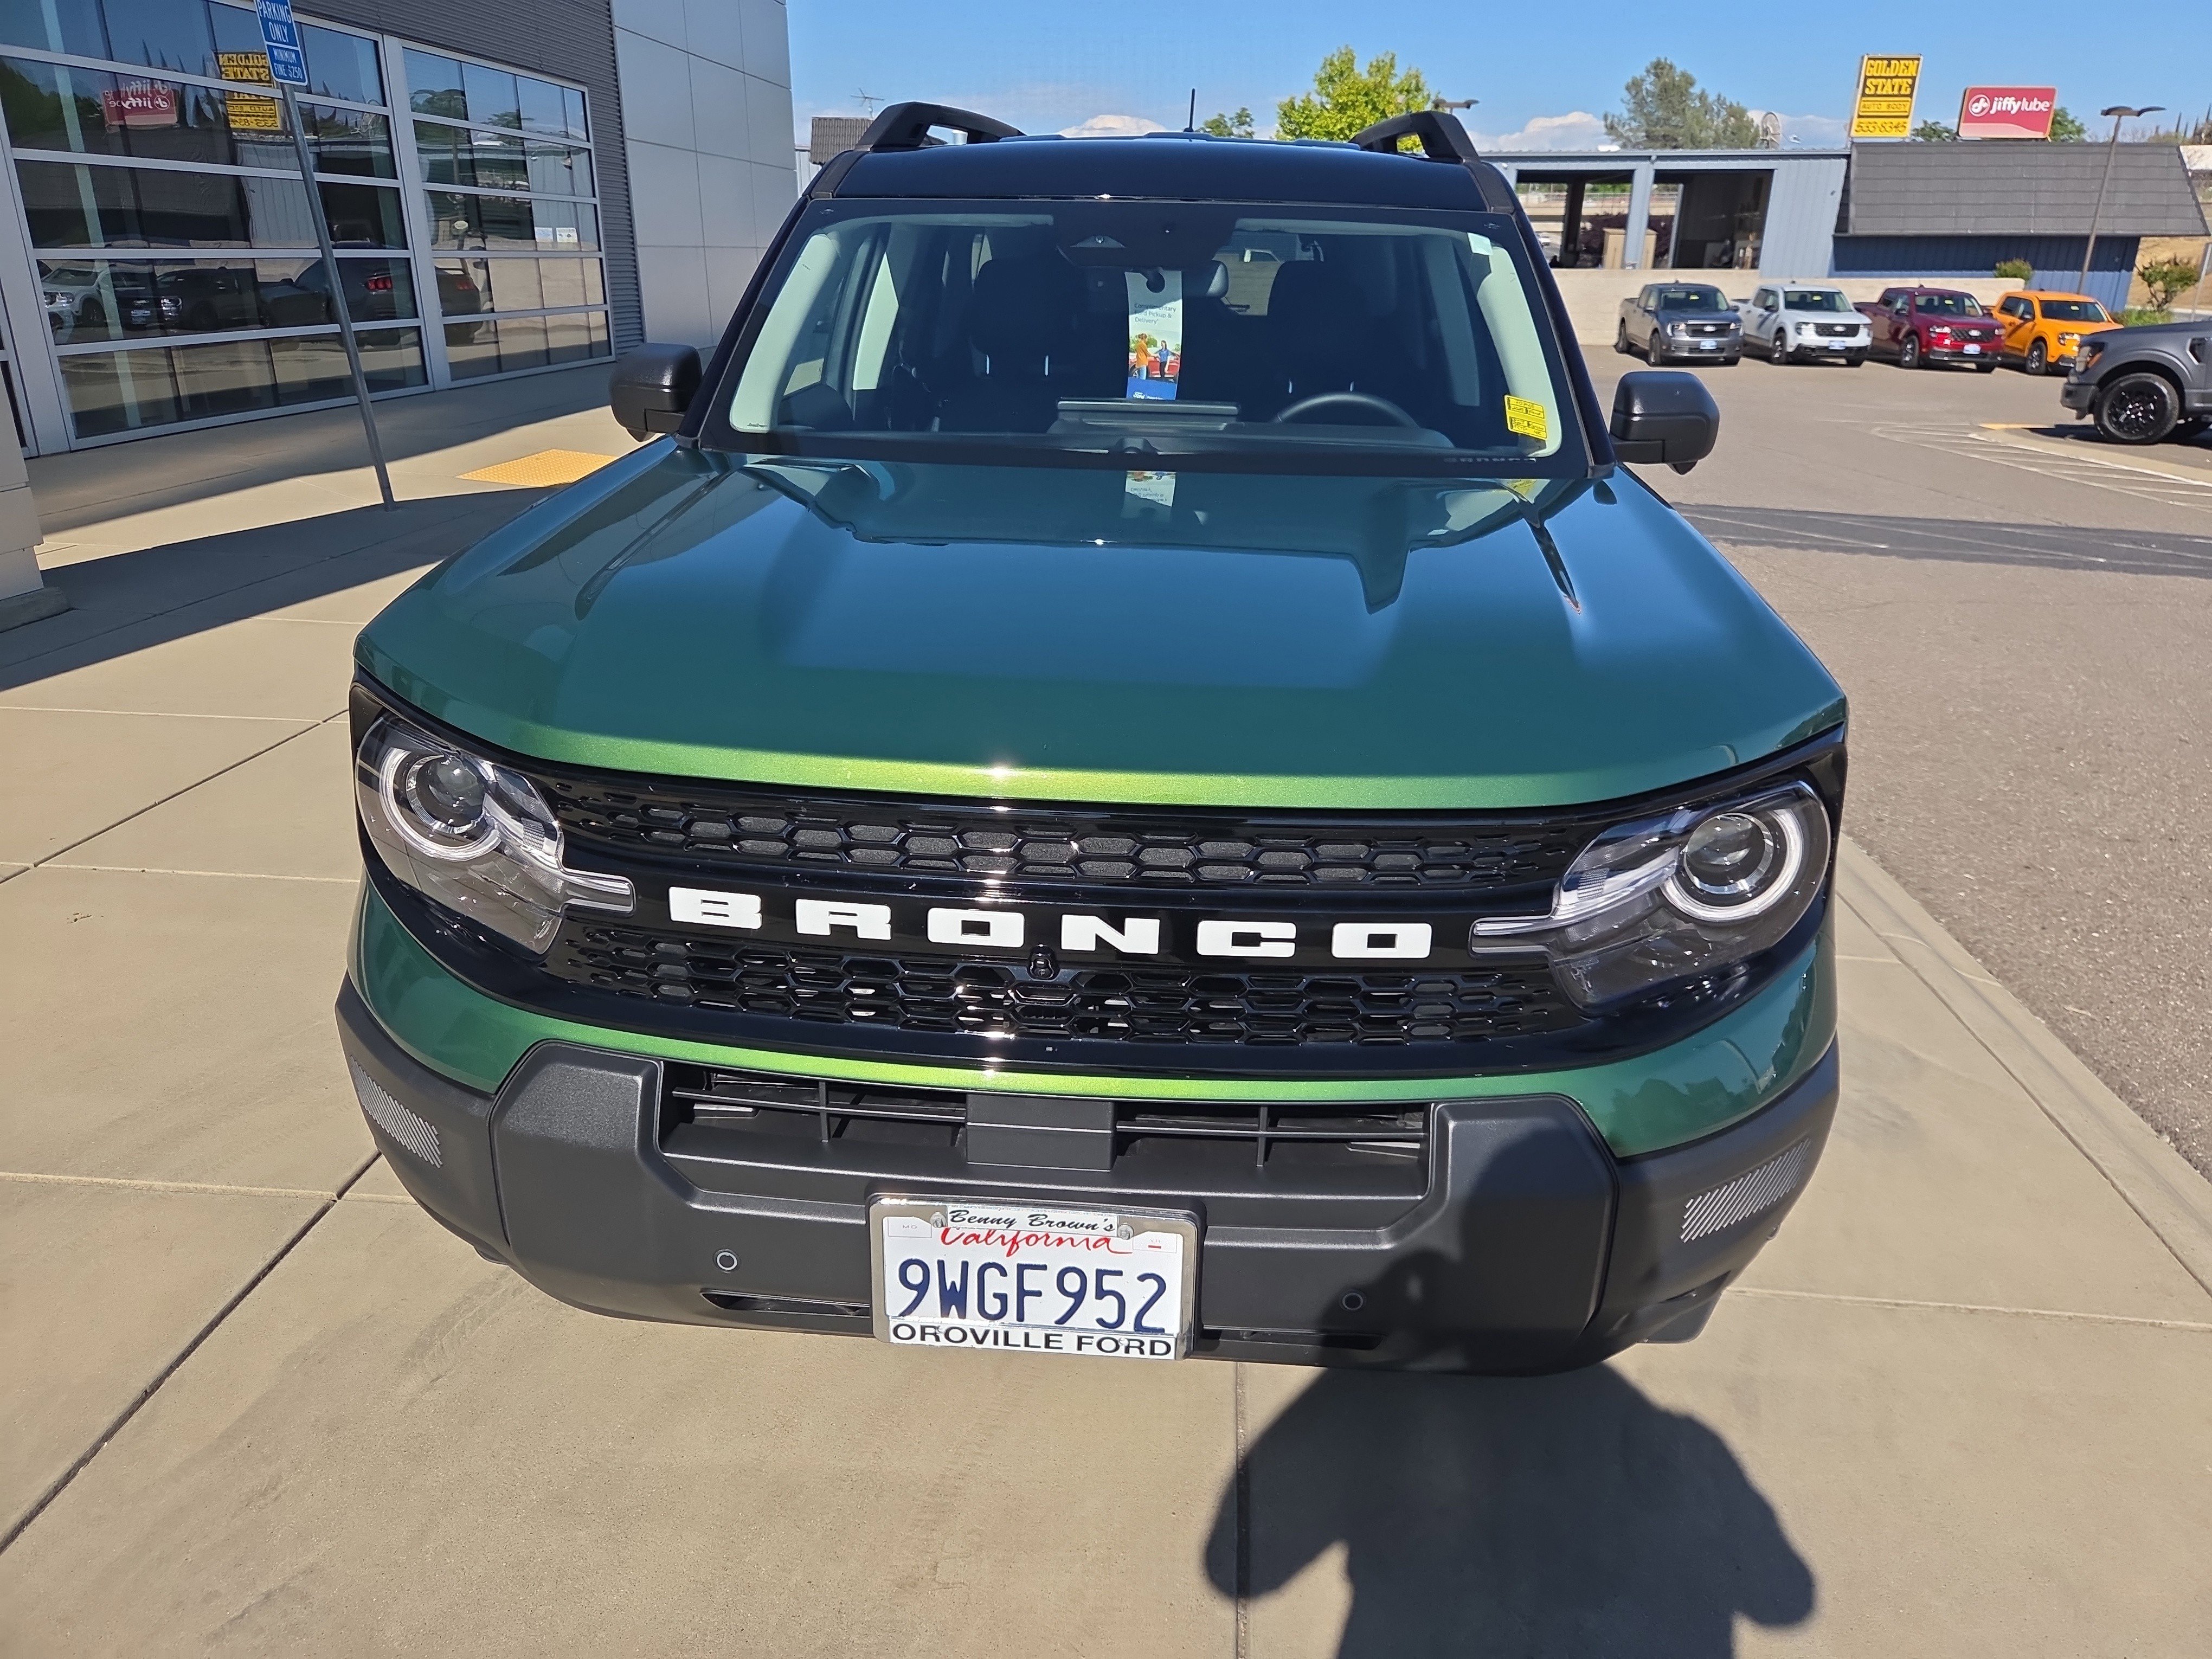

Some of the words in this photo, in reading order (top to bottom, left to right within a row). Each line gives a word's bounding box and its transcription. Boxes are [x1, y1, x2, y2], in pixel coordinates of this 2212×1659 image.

[256, 0, 292, 24] PARKING
[268, 22, 289, 42] ONLY
[273, 48, 297, 63] MINIMUM
[274, 63, 287, 77] FINE
[287, 66, 303, 79] $250
[1866, 60, 1919, 77] GOLDEN
[1864, 78, 1913, 95] STATE
[667, 886, 1433, 960] BRONCO
[949, 1210, 1018, 1229] Benny
[1028, 1214, 1116, 1232] Brown's
[940, 1226, 1133, 1257] California
[898, 1258, 1167, 1333] 9WGF952
[892, 1322, 1064, 1350] OROVILLE
[1077, 1335, 1172, 1357] FORD
